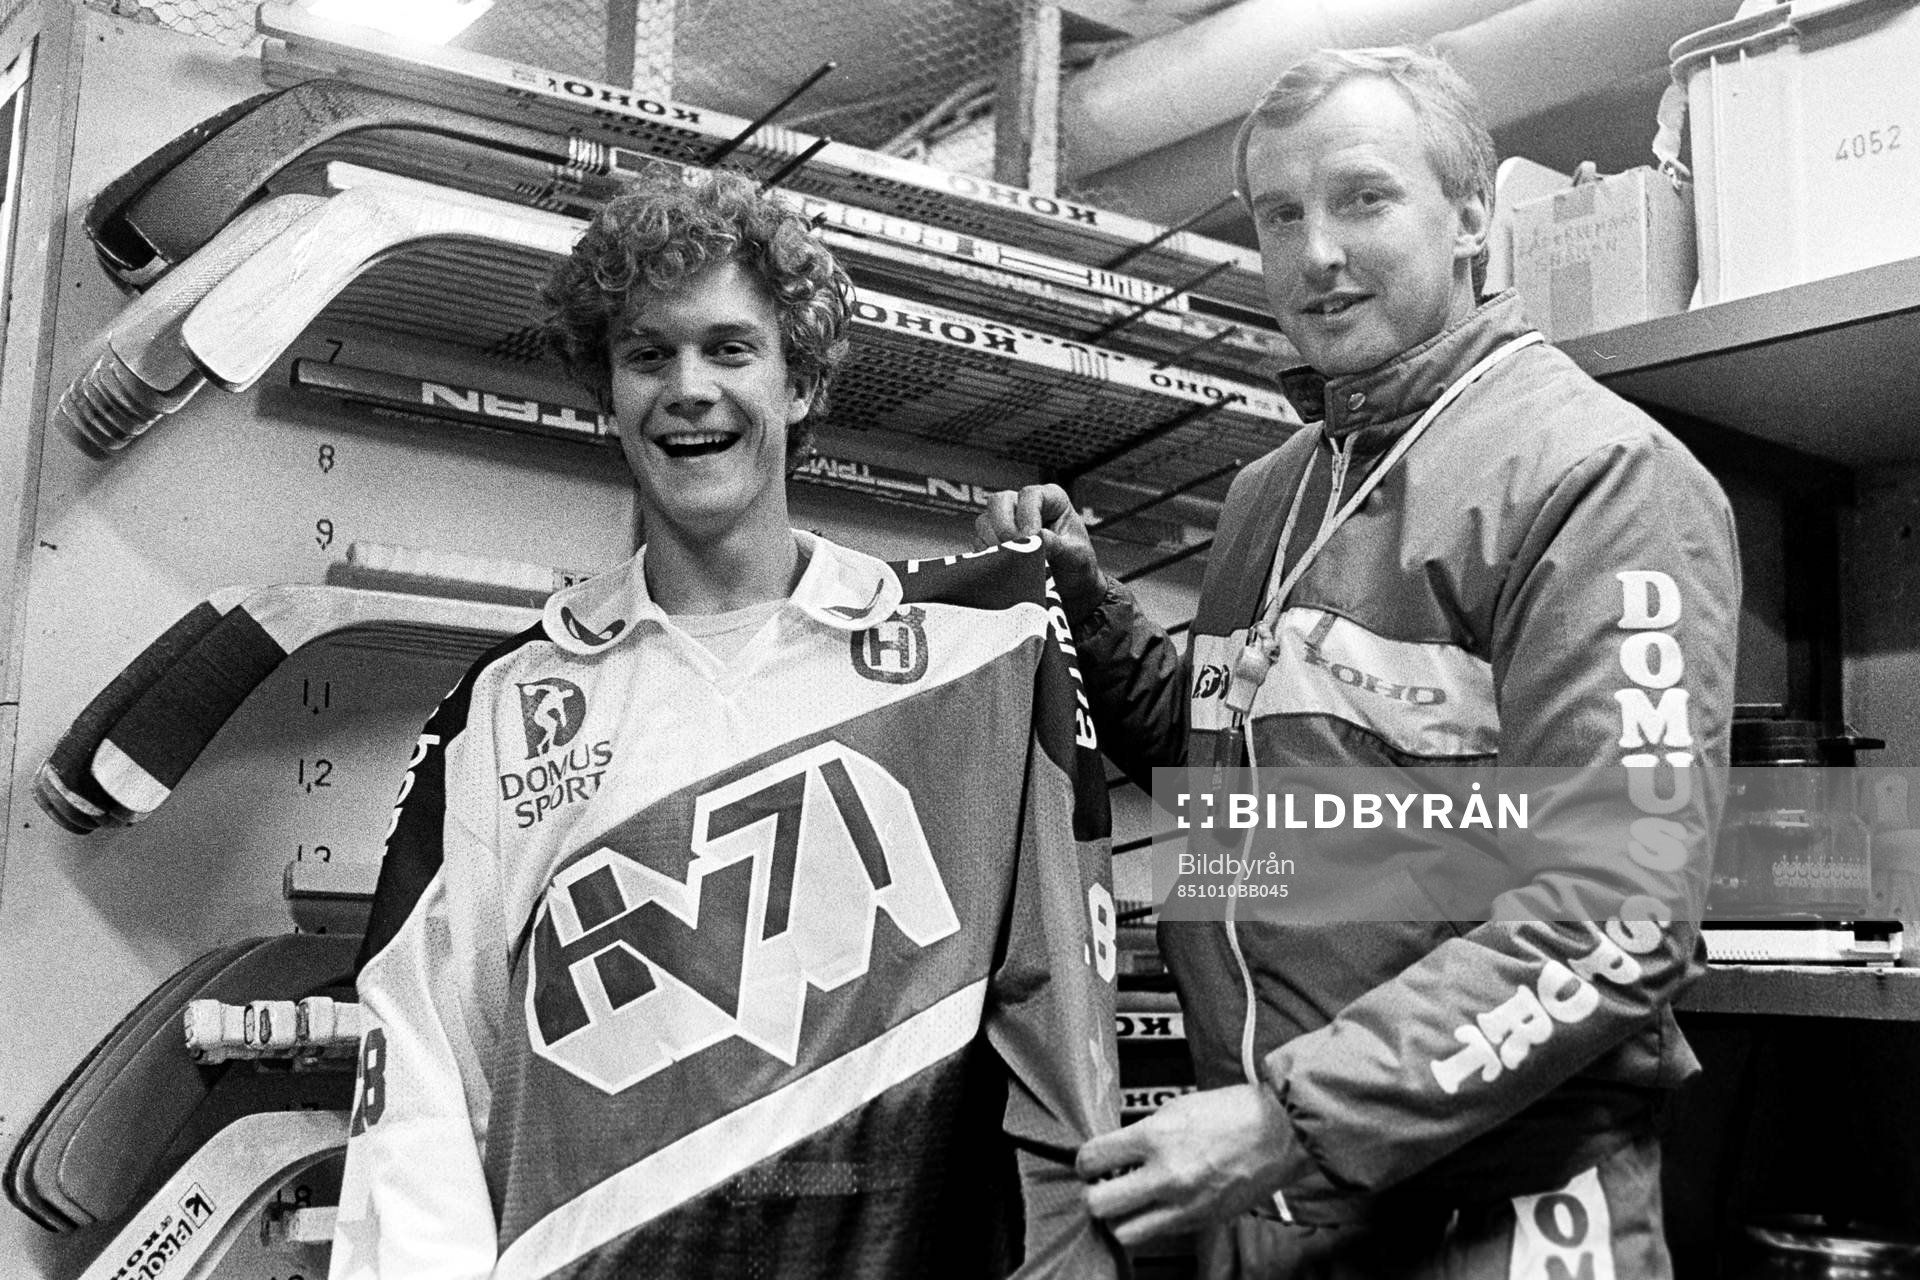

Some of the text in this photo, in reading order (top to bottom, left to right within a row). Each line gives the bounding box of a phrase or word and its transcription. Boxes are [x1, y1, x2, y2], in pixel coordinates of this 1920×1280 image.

[564, 81, 700, 124] KOHO
[1836, 125, 1901, 160] 4052
[948, 175, 1097, 226] KOHO
[851, 300, 1018, 354] KOHO
[327, 339, 343, 364] 7
[319, 444, 334, 472] 8
[316, 518, 333, 546] 9
[1616, 570, 1695, 872] DOMUS
[299, 759, 332, 788] 12
[500, 741, 613, 800] DOMUS
[515, 771, 607, 829] SPORT
[1431, 895, 1672, 1094] SPORT
